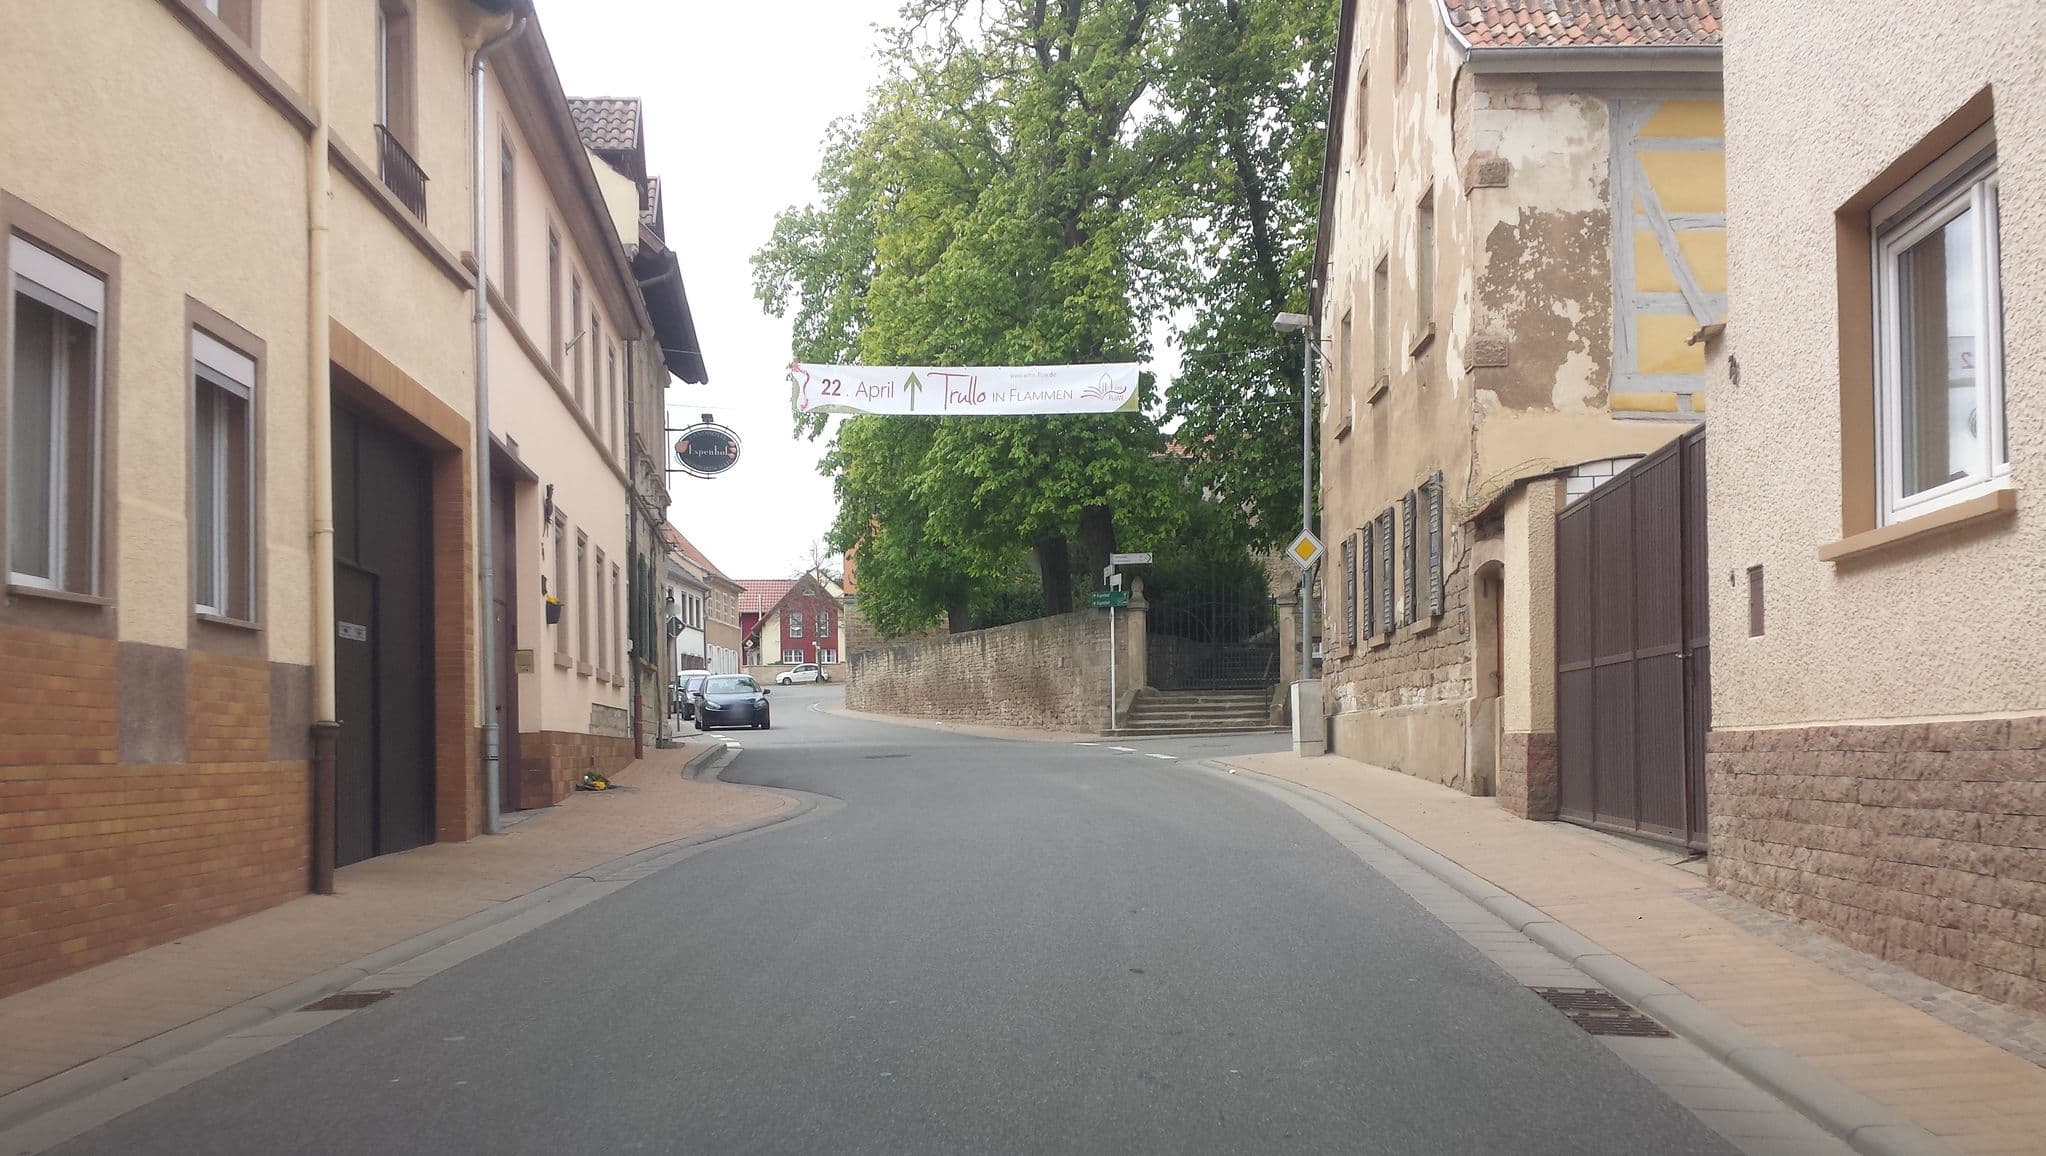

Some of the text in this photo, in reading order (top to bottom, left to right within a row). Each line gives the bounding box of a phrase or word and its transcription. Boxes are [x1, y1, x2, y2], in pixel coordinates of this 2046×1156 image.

[855, 381, 895, 402] April
[927, 372, 986, 411] Trullo
[1009, 388, 1073, 403] FLAMMEN
